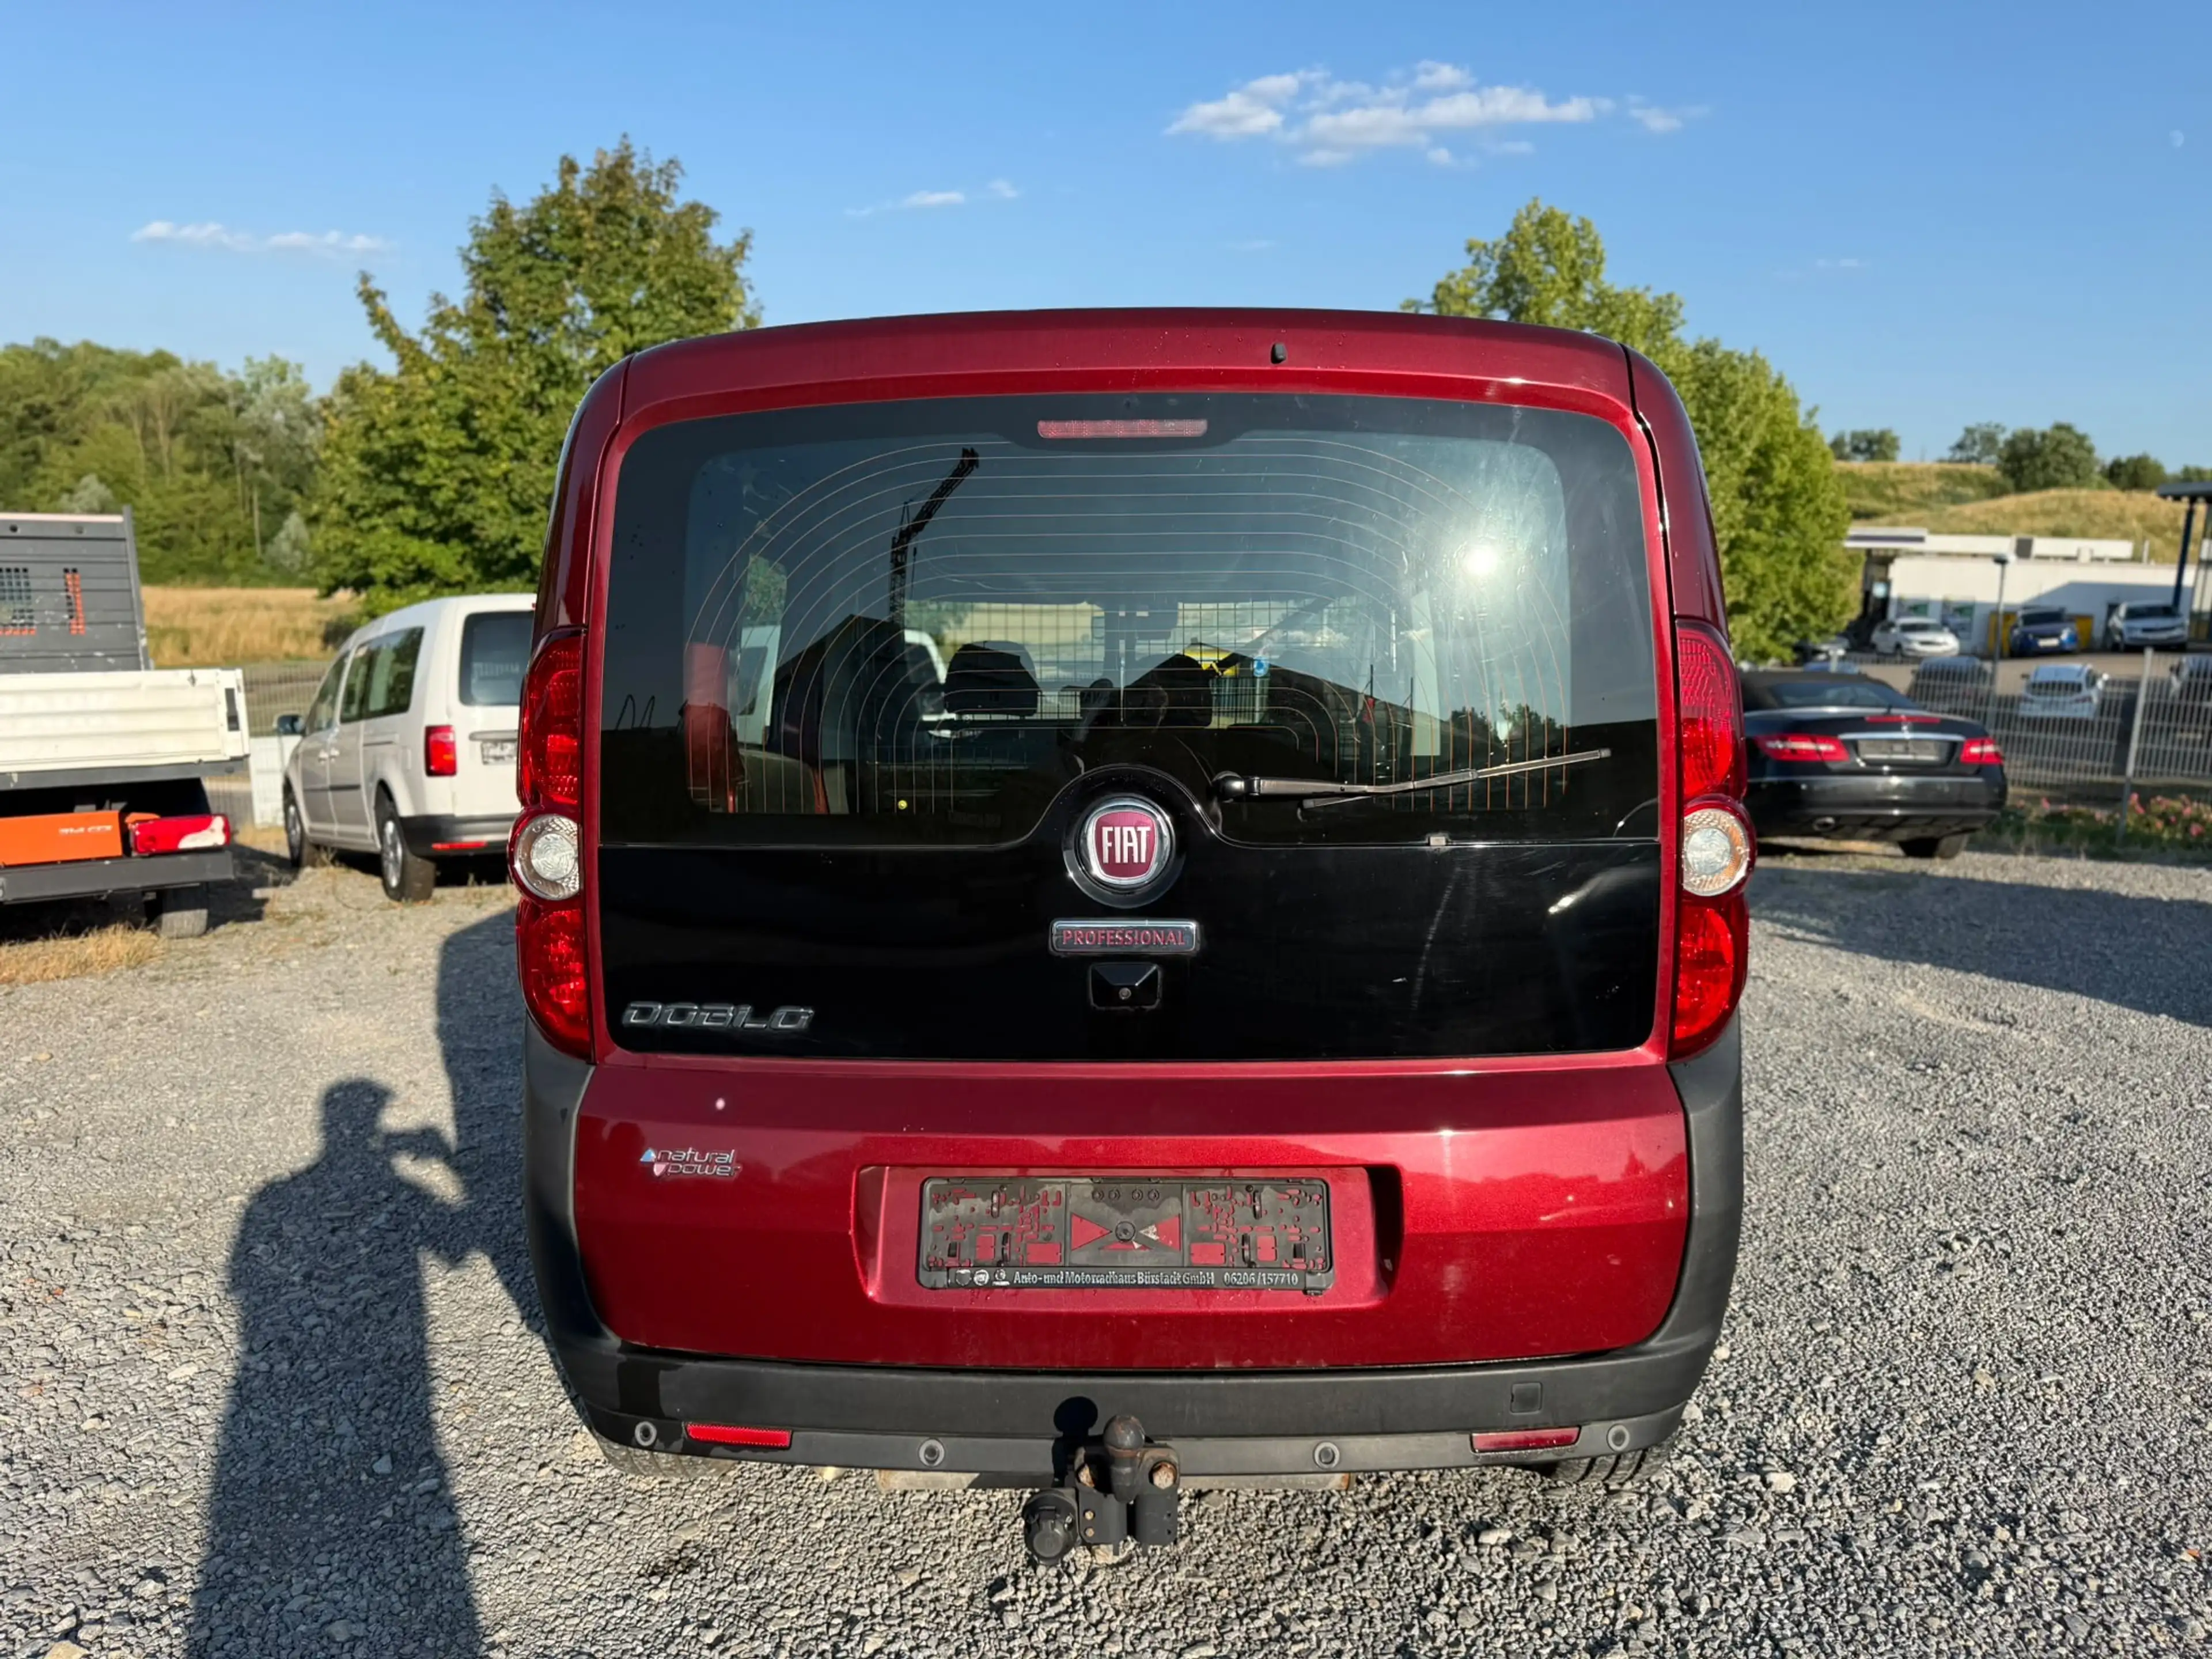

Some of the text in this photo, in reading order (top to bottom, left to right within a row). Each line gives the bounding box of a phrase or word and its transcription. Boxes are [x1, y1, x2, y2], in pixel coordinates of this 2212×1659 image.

[1101, 826, 1150, 863] FIAT
[1062, 930, 1185, 945] PROFESSIONAL
[657, 1147, 735, 1163] natural
[667, 1162, 742, 1176] power
[1182, 1271, 1214, 1285] GmbH
